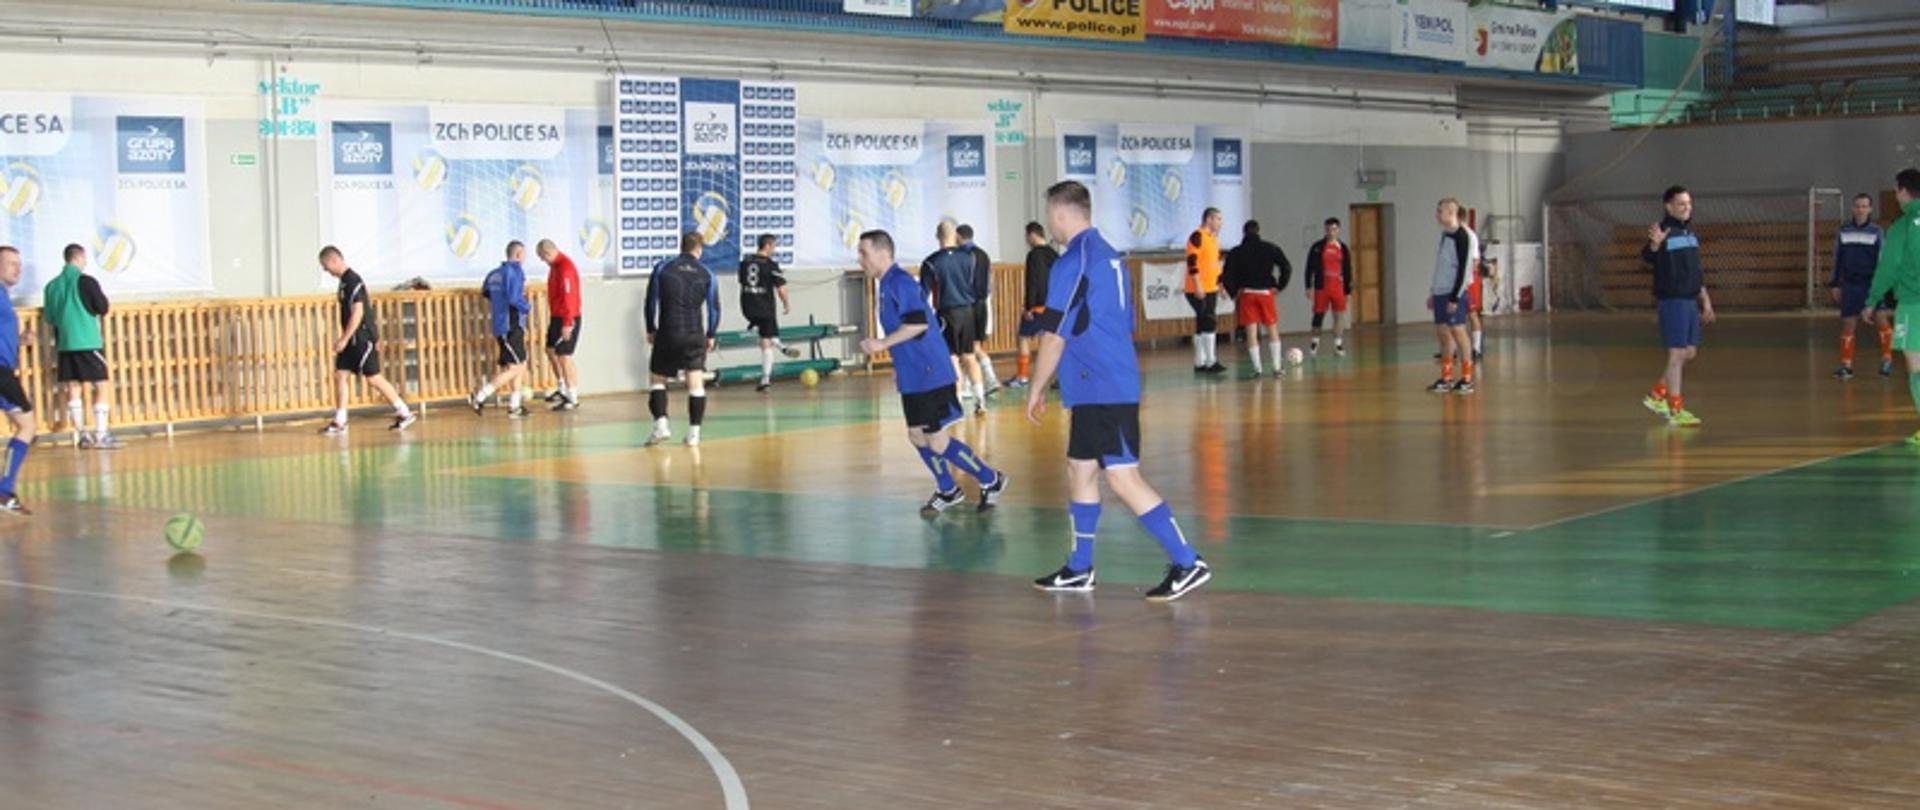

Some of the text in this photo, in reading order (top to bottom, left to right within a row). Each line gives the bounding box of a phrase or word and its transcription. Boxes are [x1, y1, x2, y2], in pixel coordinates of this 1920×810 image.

[1053, 0, 1140, 16] POLICE
[1016, 17, 1137, 36] www.police.pl
[35, 114, 63, 133] SA
[435, 123, 560, 141] ZCh POLICE SA
[826, 134, 918, 150] ZCh POLICE SA
[1121, 136, 1192, 150] ZCh POLICE SA
[138, 179, 171, 190] POLICE
[174, 179, 187, 190] SA
[382, 180, 394, 189] SA
[747, 264, 759, 286] 8
